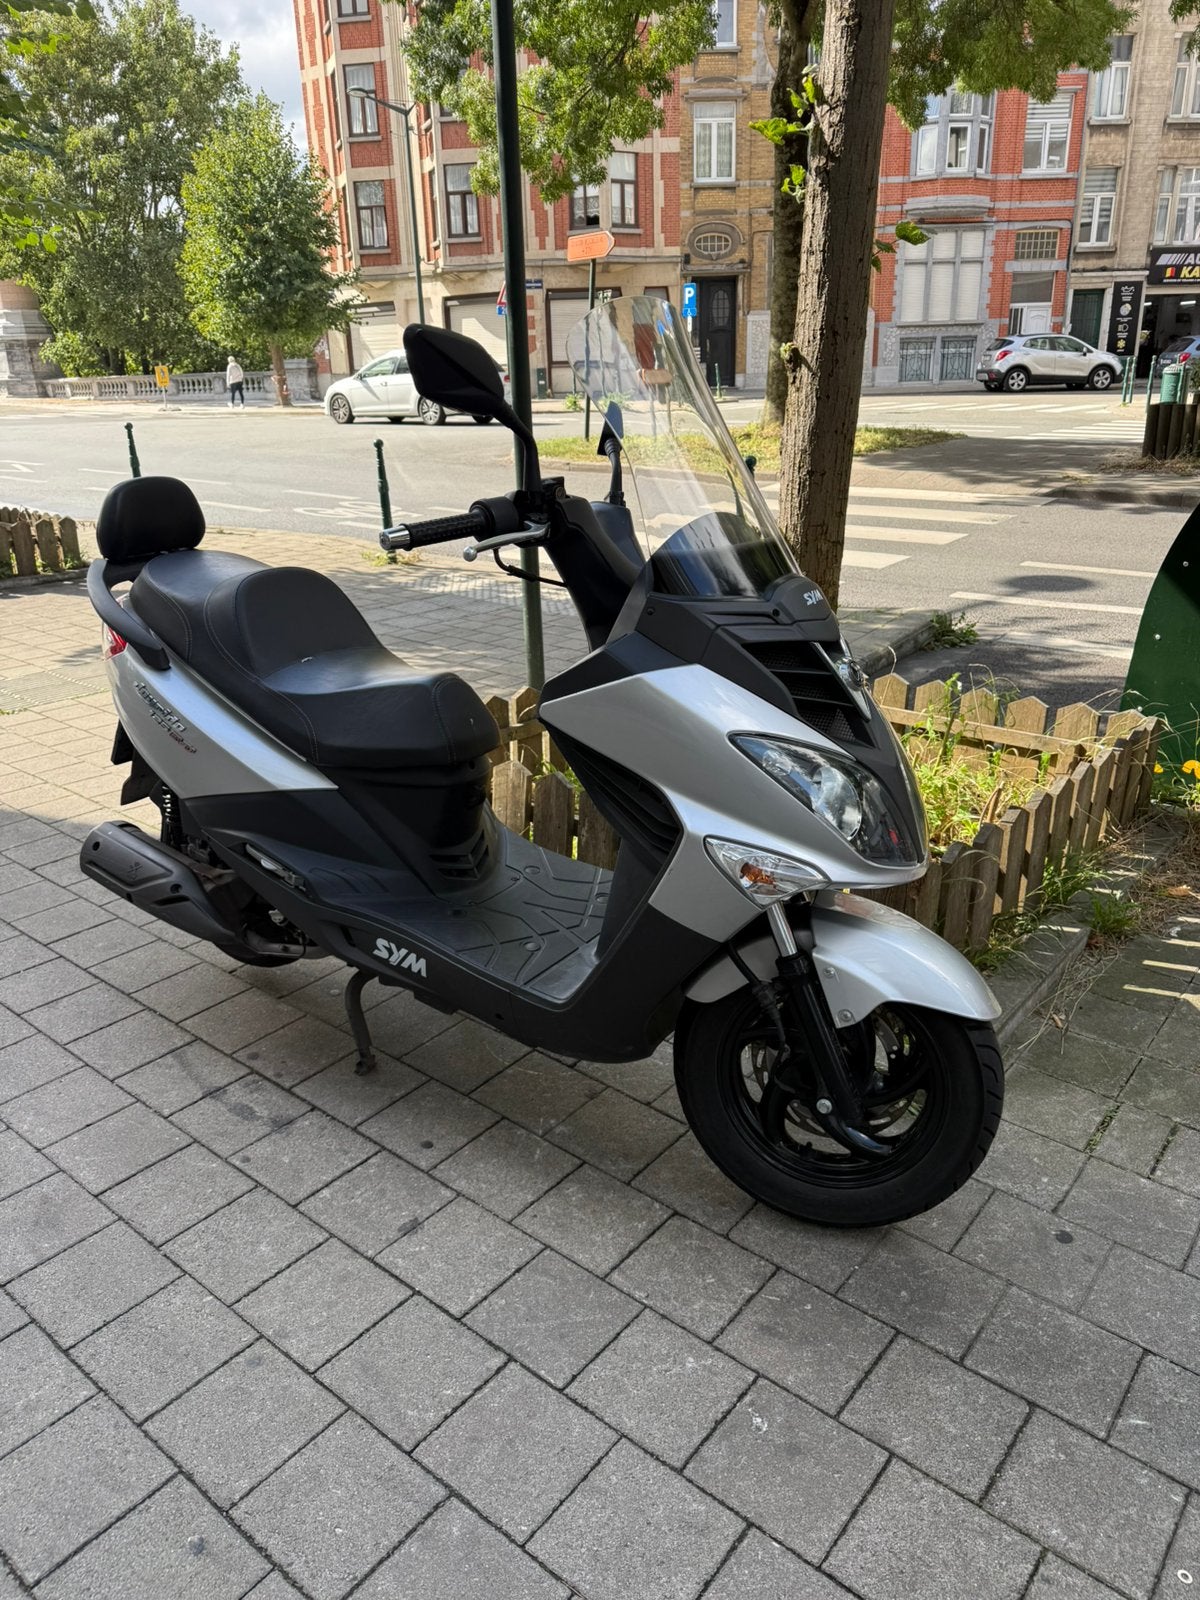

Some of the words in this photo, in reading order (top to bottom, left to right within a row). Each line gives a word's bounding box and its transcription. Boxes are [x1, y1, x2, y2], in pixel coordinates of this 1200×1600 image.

[685, 287, 695, 304] P
[803, 589, 824, 606] SYM
[372, 937, 427, 979] SYM
